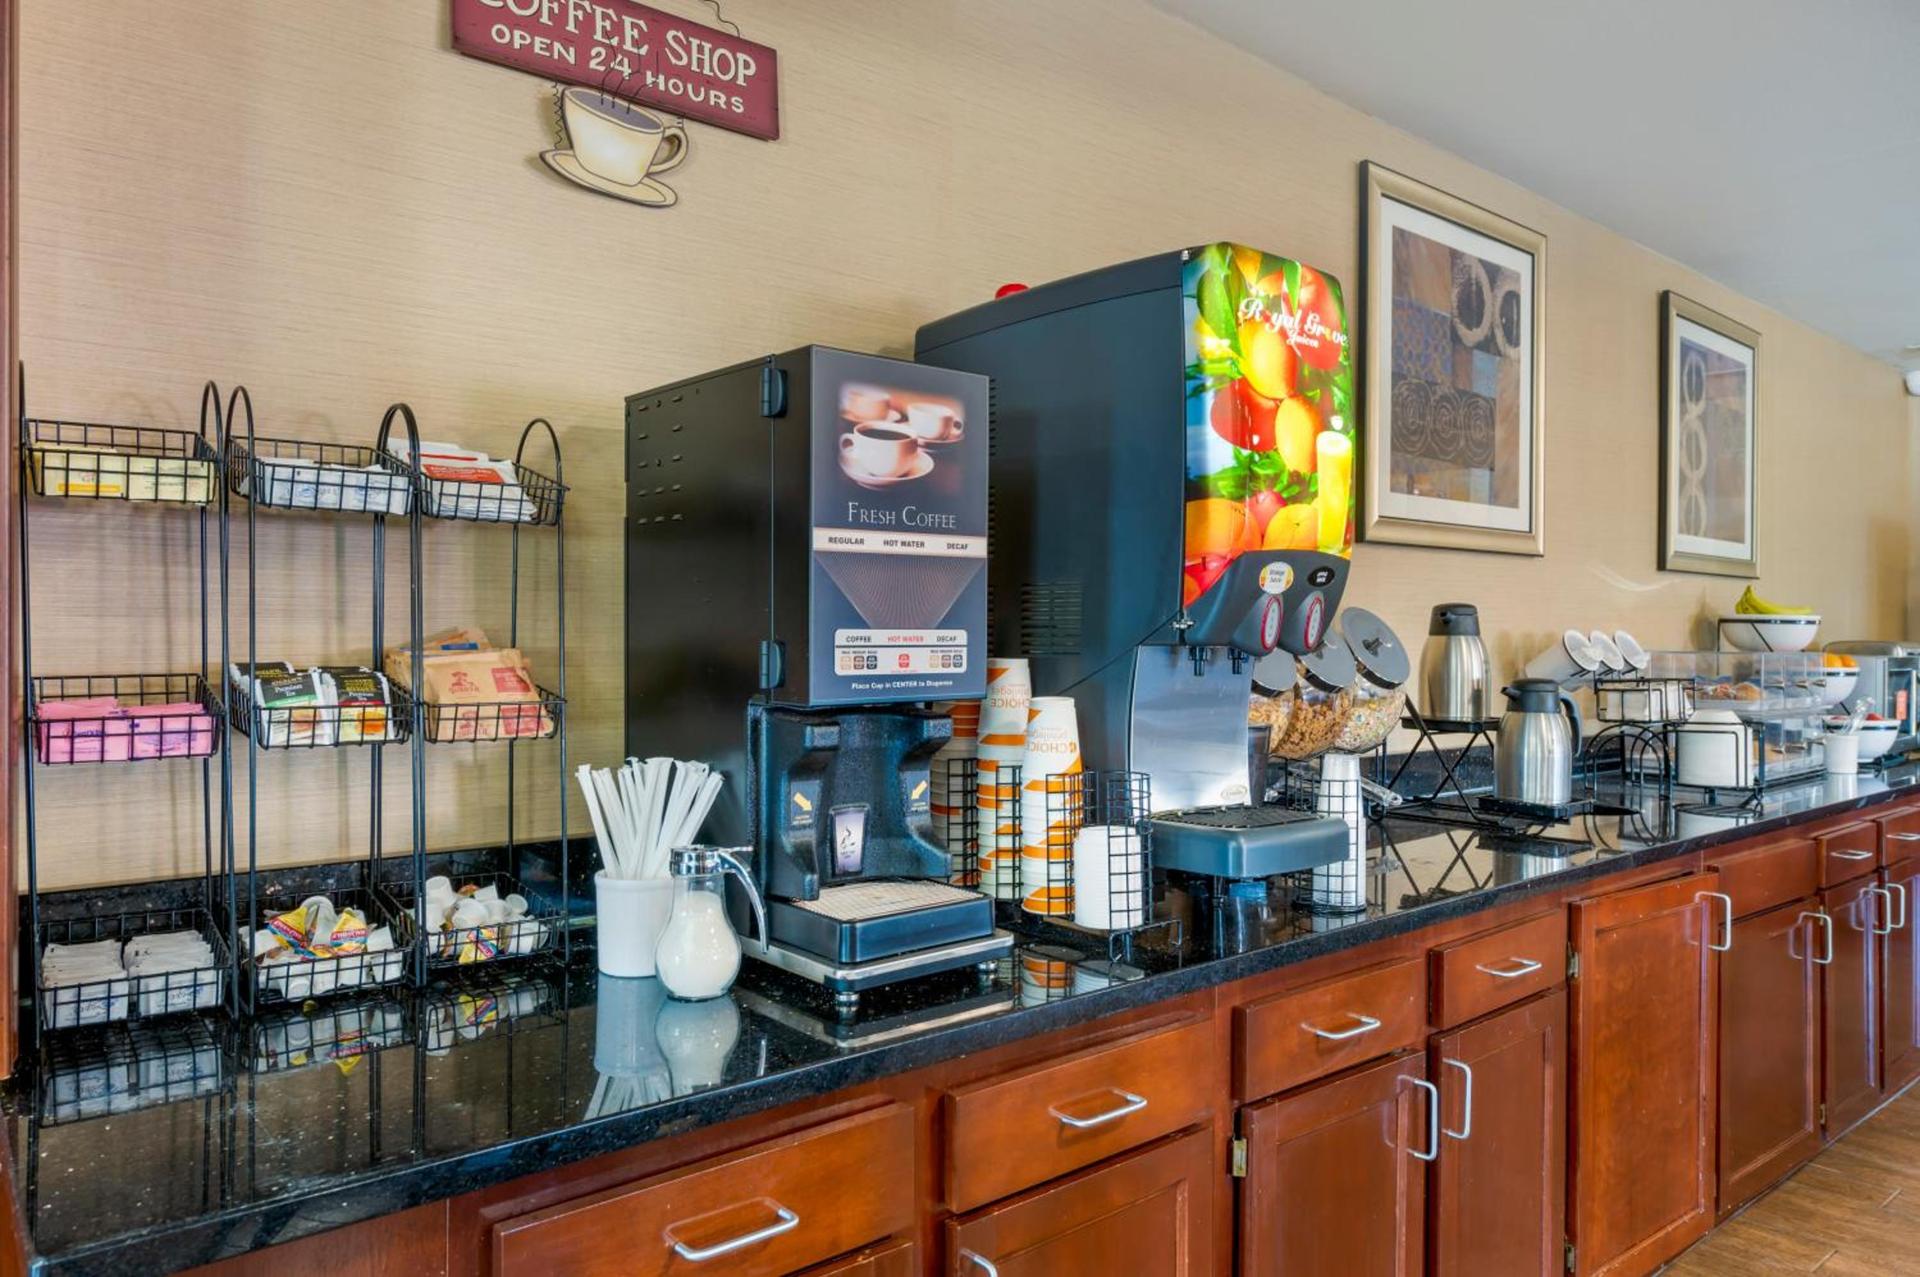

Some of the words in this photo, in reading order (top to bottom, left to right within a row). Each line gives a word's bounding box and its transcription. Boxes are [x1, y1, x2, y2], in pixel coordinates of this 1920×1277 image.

[479, 0, 649, 55] OFFEE
[665, 30, 757, 87] SHOP
[490, 24, 576, 65] OPEN
[588, 47, 632, 79] 24
[646, 70, 745, 113] HOURS
[828, 536, 865, 546] REGULAR
[883, 539, 899, 548] HOT
[900, 540, 926, 549] WATER
[946, 543, 969, 551] DECAF
[845, 635, 872, 643] COFFEE
[887, 635, 902, 643] HOT
[903, 635, 925, 643] WATER
[936, 635, 957, 643] DECAF
[892, 680, 918, 689] CENTER
[1030, 742, 1068, 752] CHOIC
